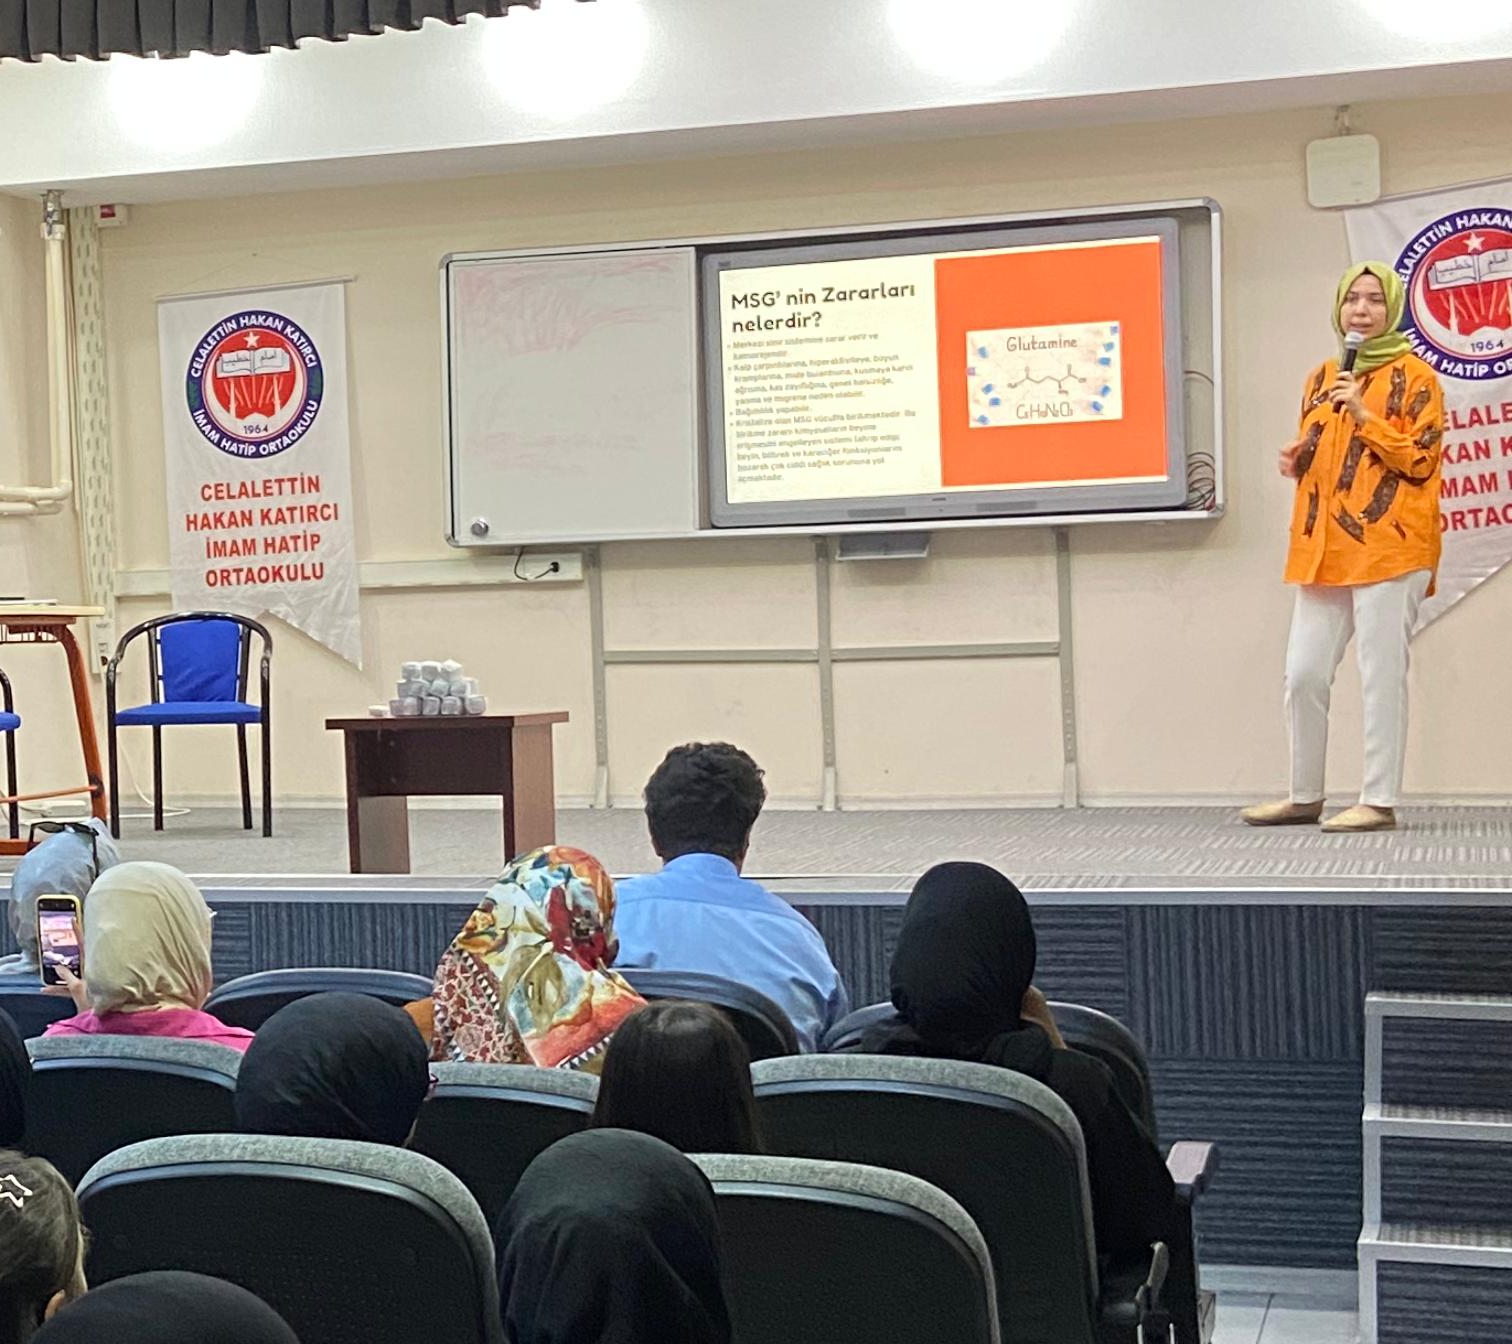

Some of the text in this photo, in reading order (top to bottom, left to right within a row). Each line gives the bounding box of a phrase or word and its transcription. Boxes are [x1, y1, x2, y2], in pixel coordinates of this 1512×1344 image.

[1399, 221, 1453, 288] ELALETTİN
[786, 288, 816, 306] nin
[821, 282, 916, 304] Zararları
[732, 311, 822, 333] nelerdir?
[190, 314, 317, 378] CELALETTİN HAKAN KATIRCI
[1006, 333, 1078, 352] Glutamine
[1471, 339, 1505, 353] 1964
[1440, 359, 1489, 377] HATİP
[193, 400, 318, 456] İMAM HATİP ORTAOKULU
[243, 424, 269, 435] 1964
[1440, 439, 1491, 464] KAN
[200, 472, 321, 502] CELALETTİN
[1440, 472, 1498, 499] MAM
[185, 503, 339, 532] HAKAN KATIRCI
[205, 530, 321, 559] İMAM HATİP
[205, 562, 325, 587] ORTAOKULU
